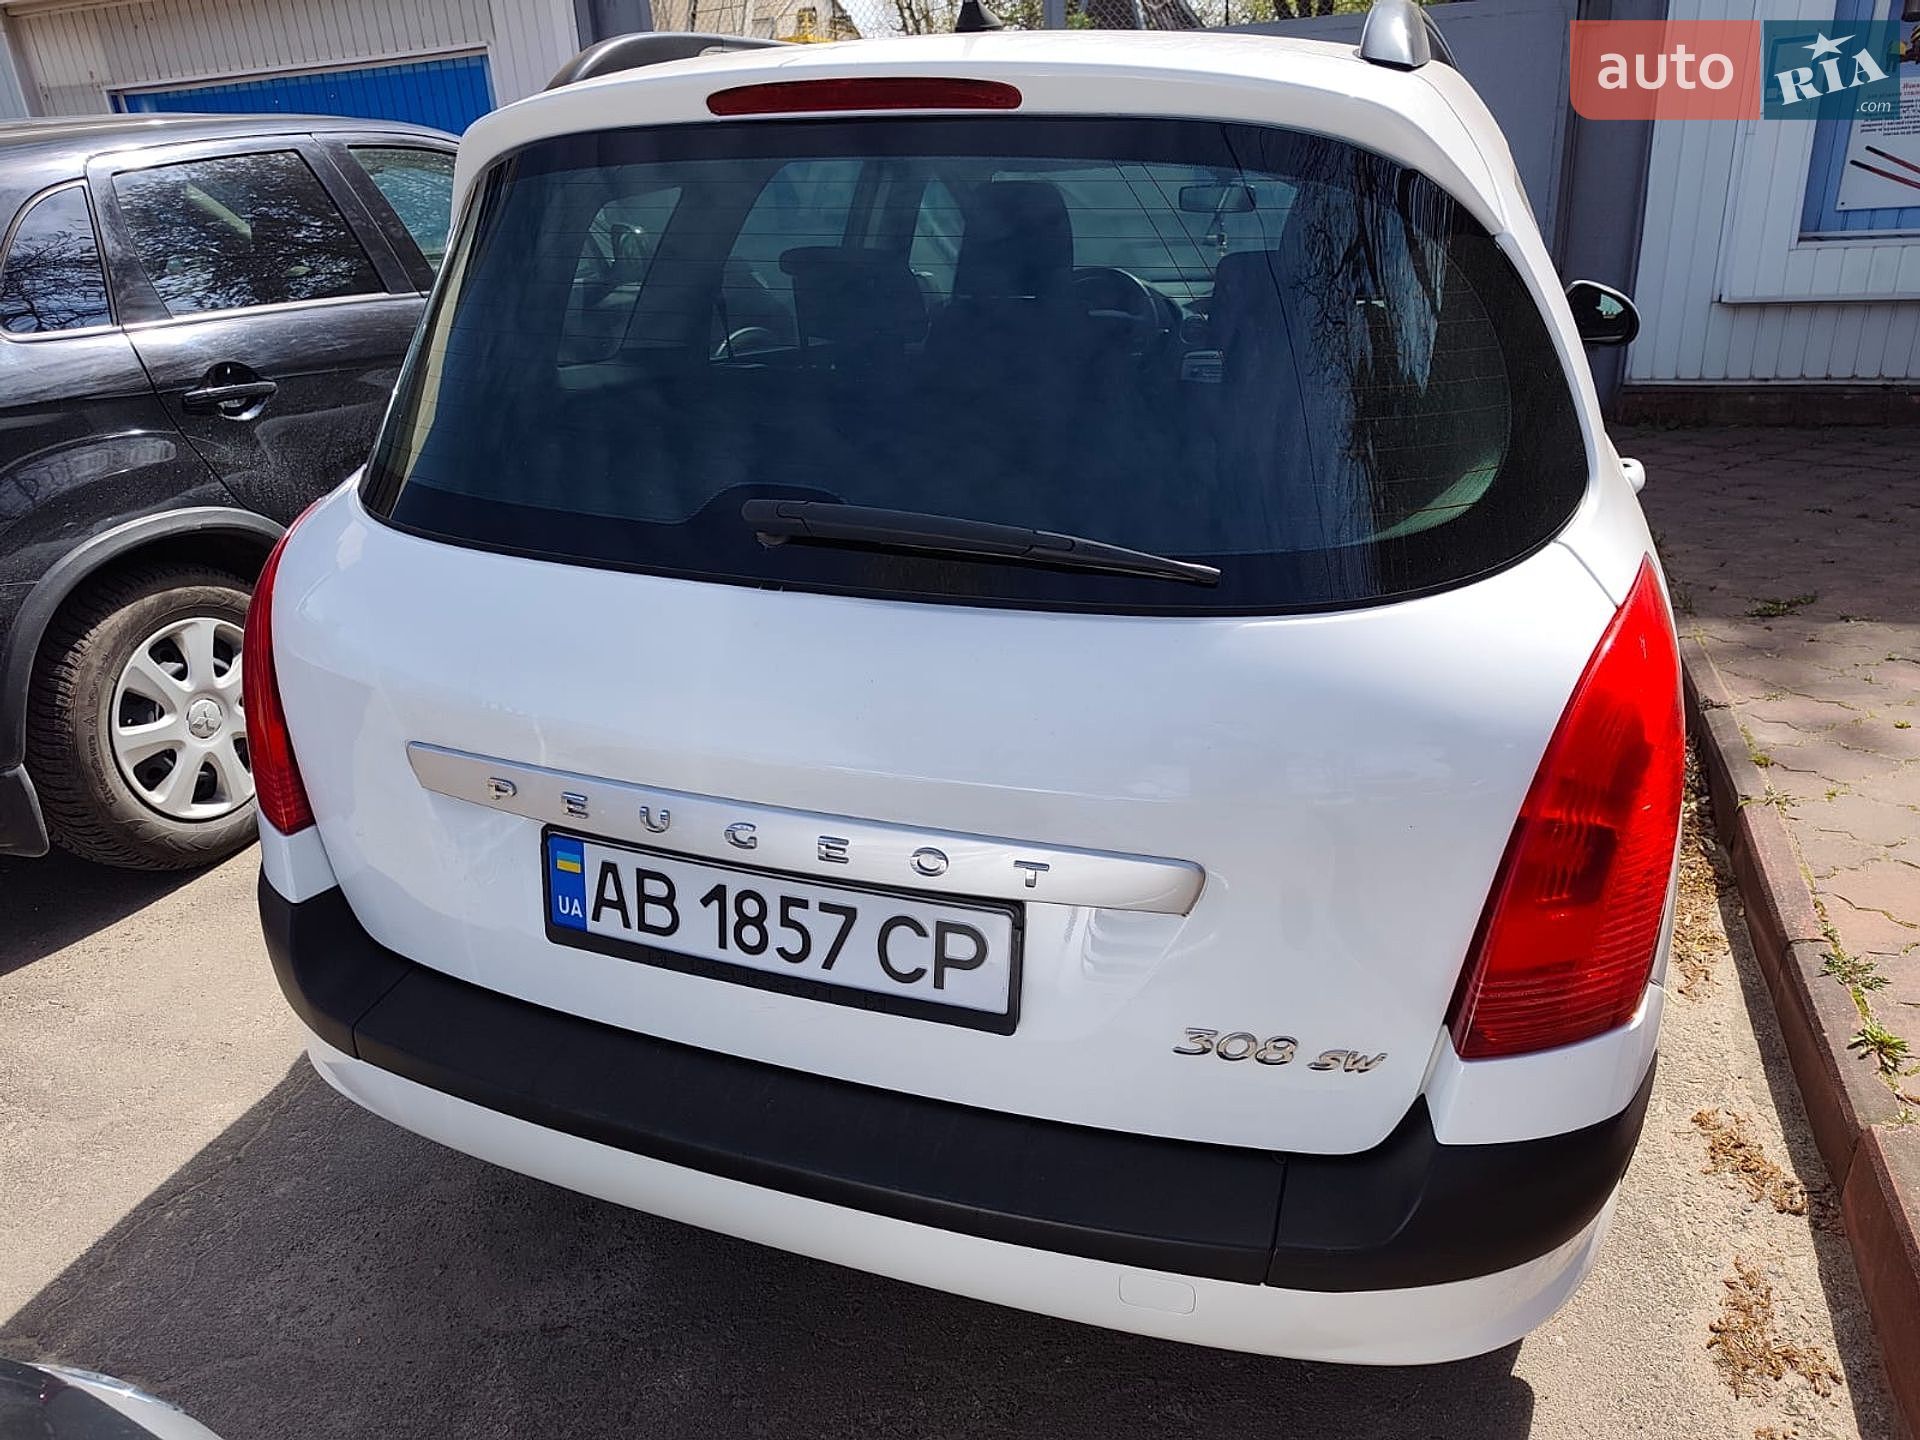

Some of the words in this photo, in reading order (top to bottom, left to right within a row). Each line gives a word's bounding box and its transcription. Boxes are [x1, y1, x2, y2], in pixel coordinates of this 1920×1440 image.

[487, 776, 1051, 889] PEUGEOT
[558, 895, 583, 919] UA
[591, 862, 681, 937] AB
[699, 884, 858, 971] 1857
[877, 915, 989, 990] CP
[1172, 1027, 1299, 1066] 308
[1307, 1050, 1388, 1074] SW
